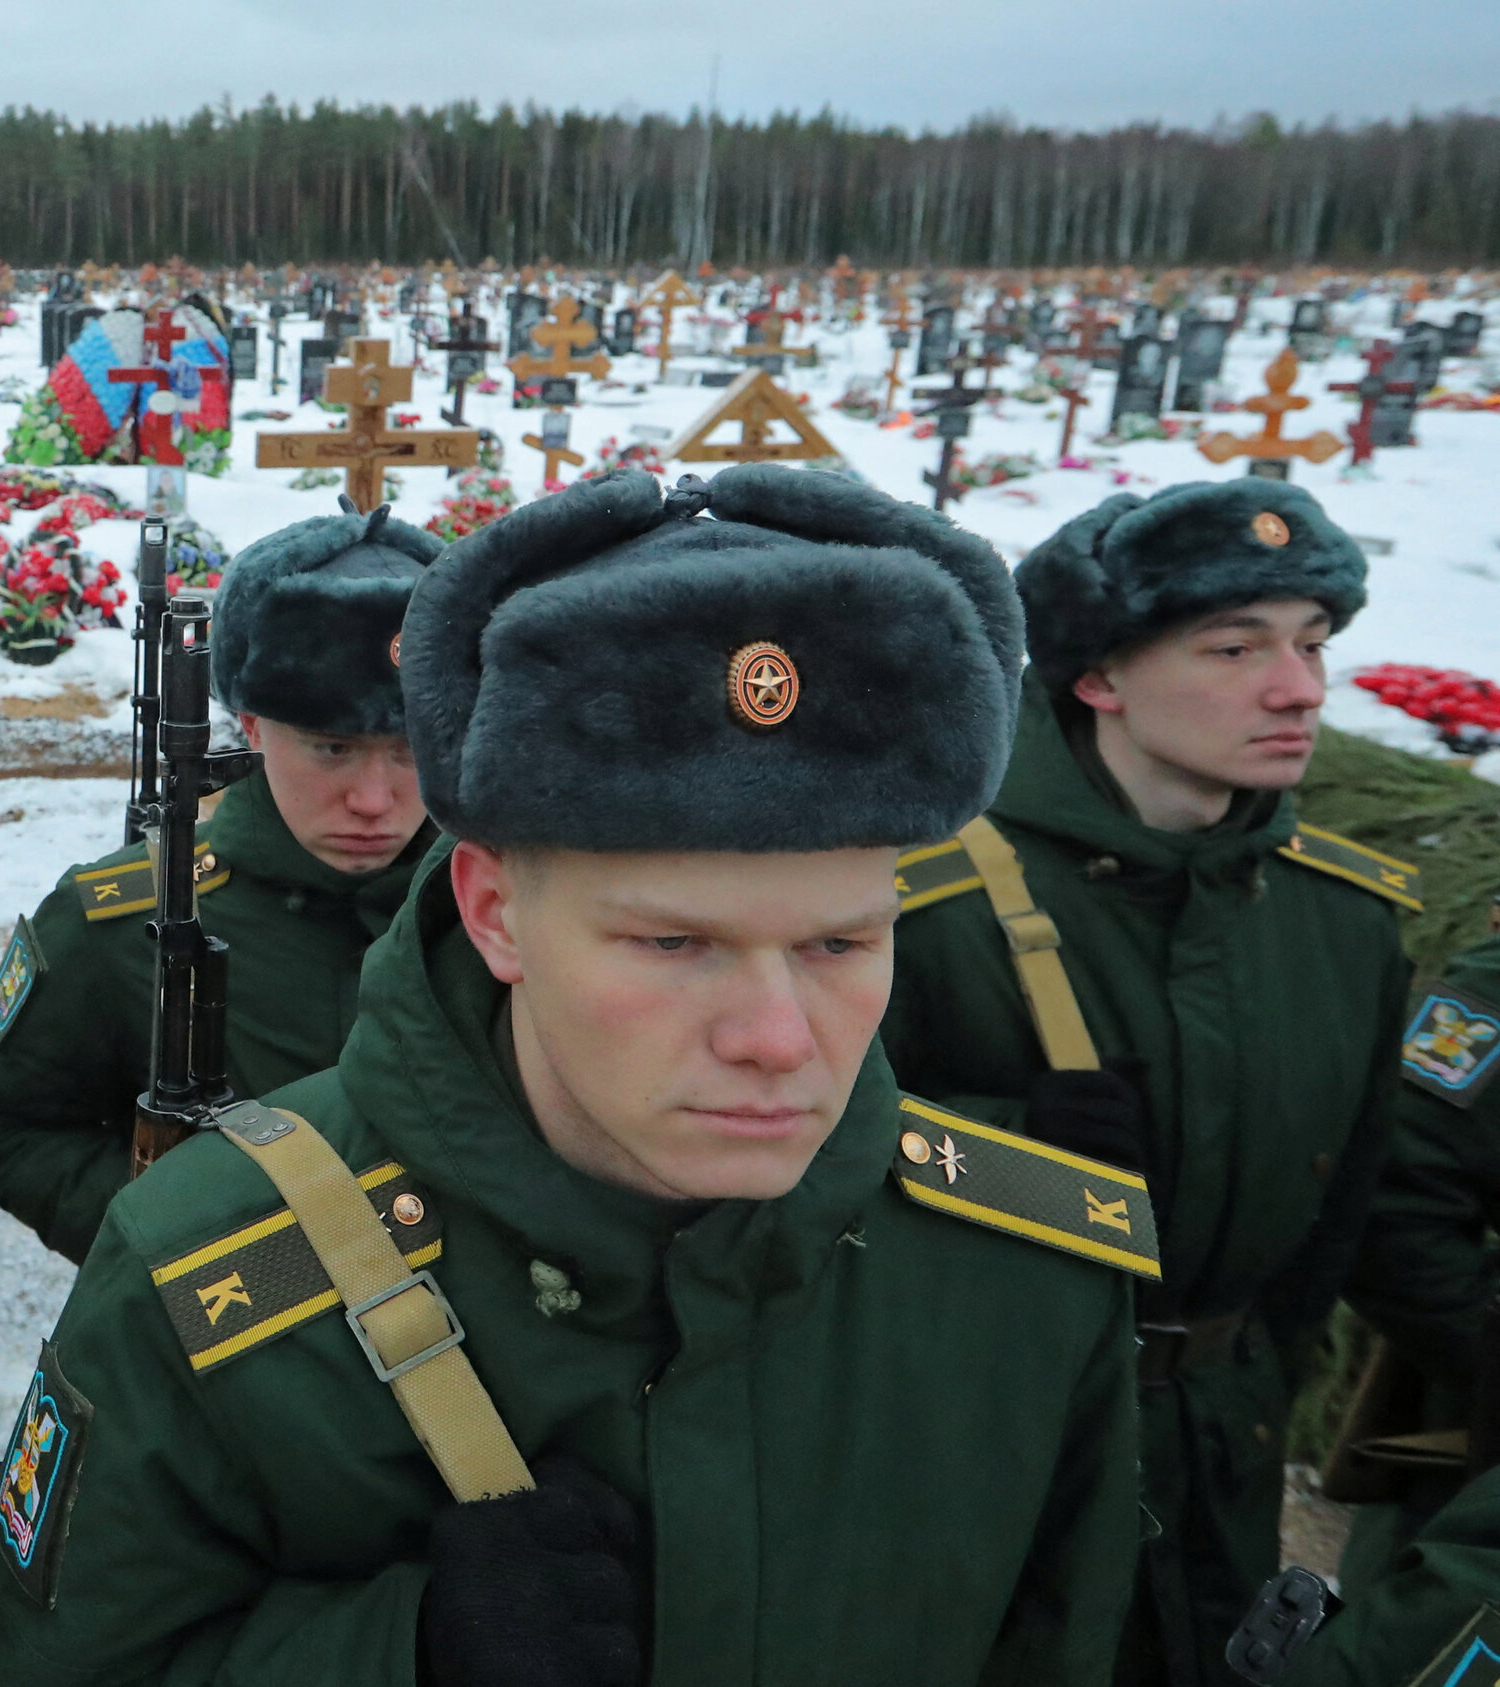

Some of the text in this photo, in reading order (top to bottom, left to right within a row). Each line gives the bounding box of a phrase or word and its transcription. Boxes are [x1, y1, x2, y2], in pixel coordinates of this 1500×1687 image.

[93, 882, 120, 901] К
[1084, 1188, 1132, 1234] К
[195, 1271, 253, 1325] К
